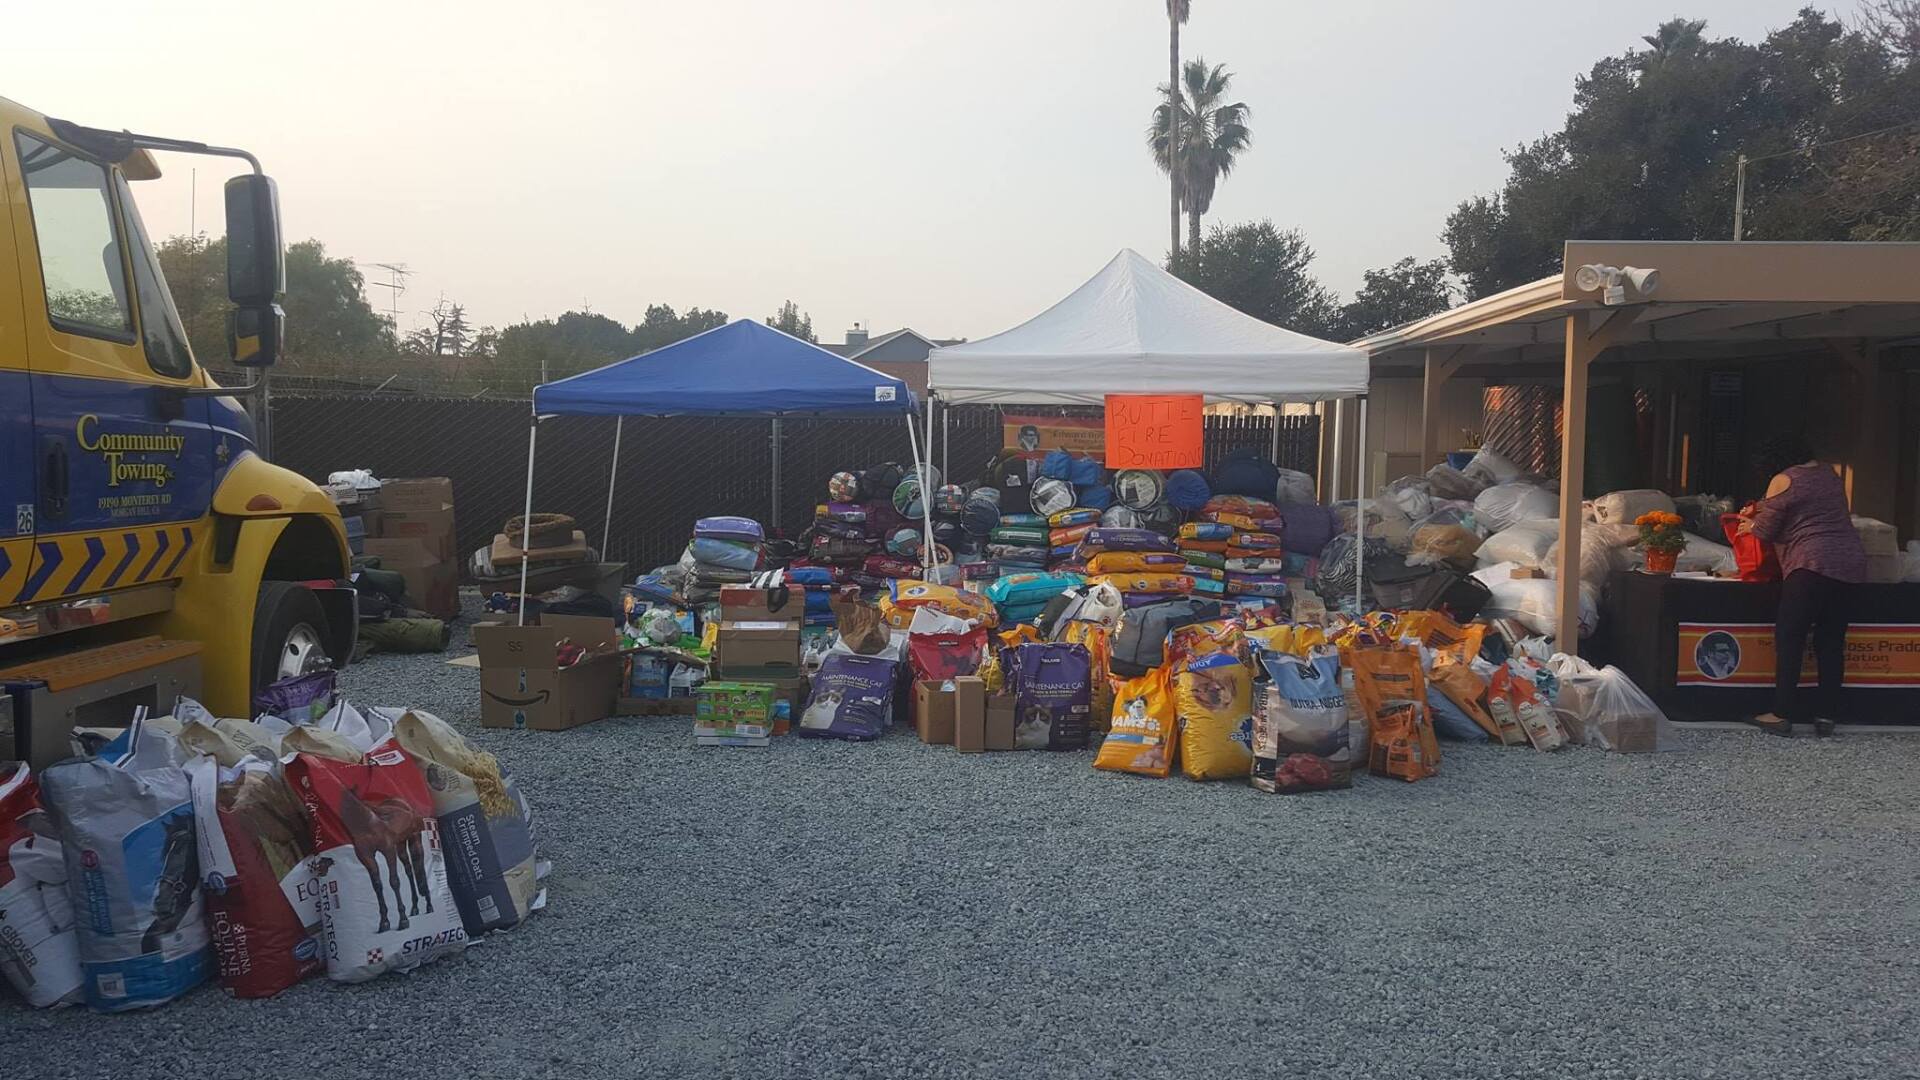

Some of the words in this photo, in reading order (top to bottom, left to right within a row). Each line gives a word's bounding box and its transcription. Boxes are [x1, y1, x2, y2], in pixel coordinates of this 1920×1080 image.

[1110, 398, 1198, 426] BUTTE
[77, 413, 185, 460] Community
[1117, 424, 1177, 443] FIRE
[103, 451, 166, 488] Towing
[98, 496, 119, 509] 19190
[121, 494, 159, 507] MONTEREY
[161, 493, 172, 505] RD
[18, 511, 32, 533] 26
[1843, 652, 1889, 663] dation
[1846, 642, 1874, 652] oss
[822, 674, 869, 684] MAINTENANCE
[465, 814, 481, 846] Steam
[457, 816, 477, 857] Crimped
[470, 857, 484, 881] Oats
[320, 883, 340, 962] STRATEGY
[213, 911, 241, 976] EQUINE
[235, 934, 252, 975] PURINA
[402, 926, 466, 955] STRATEG
